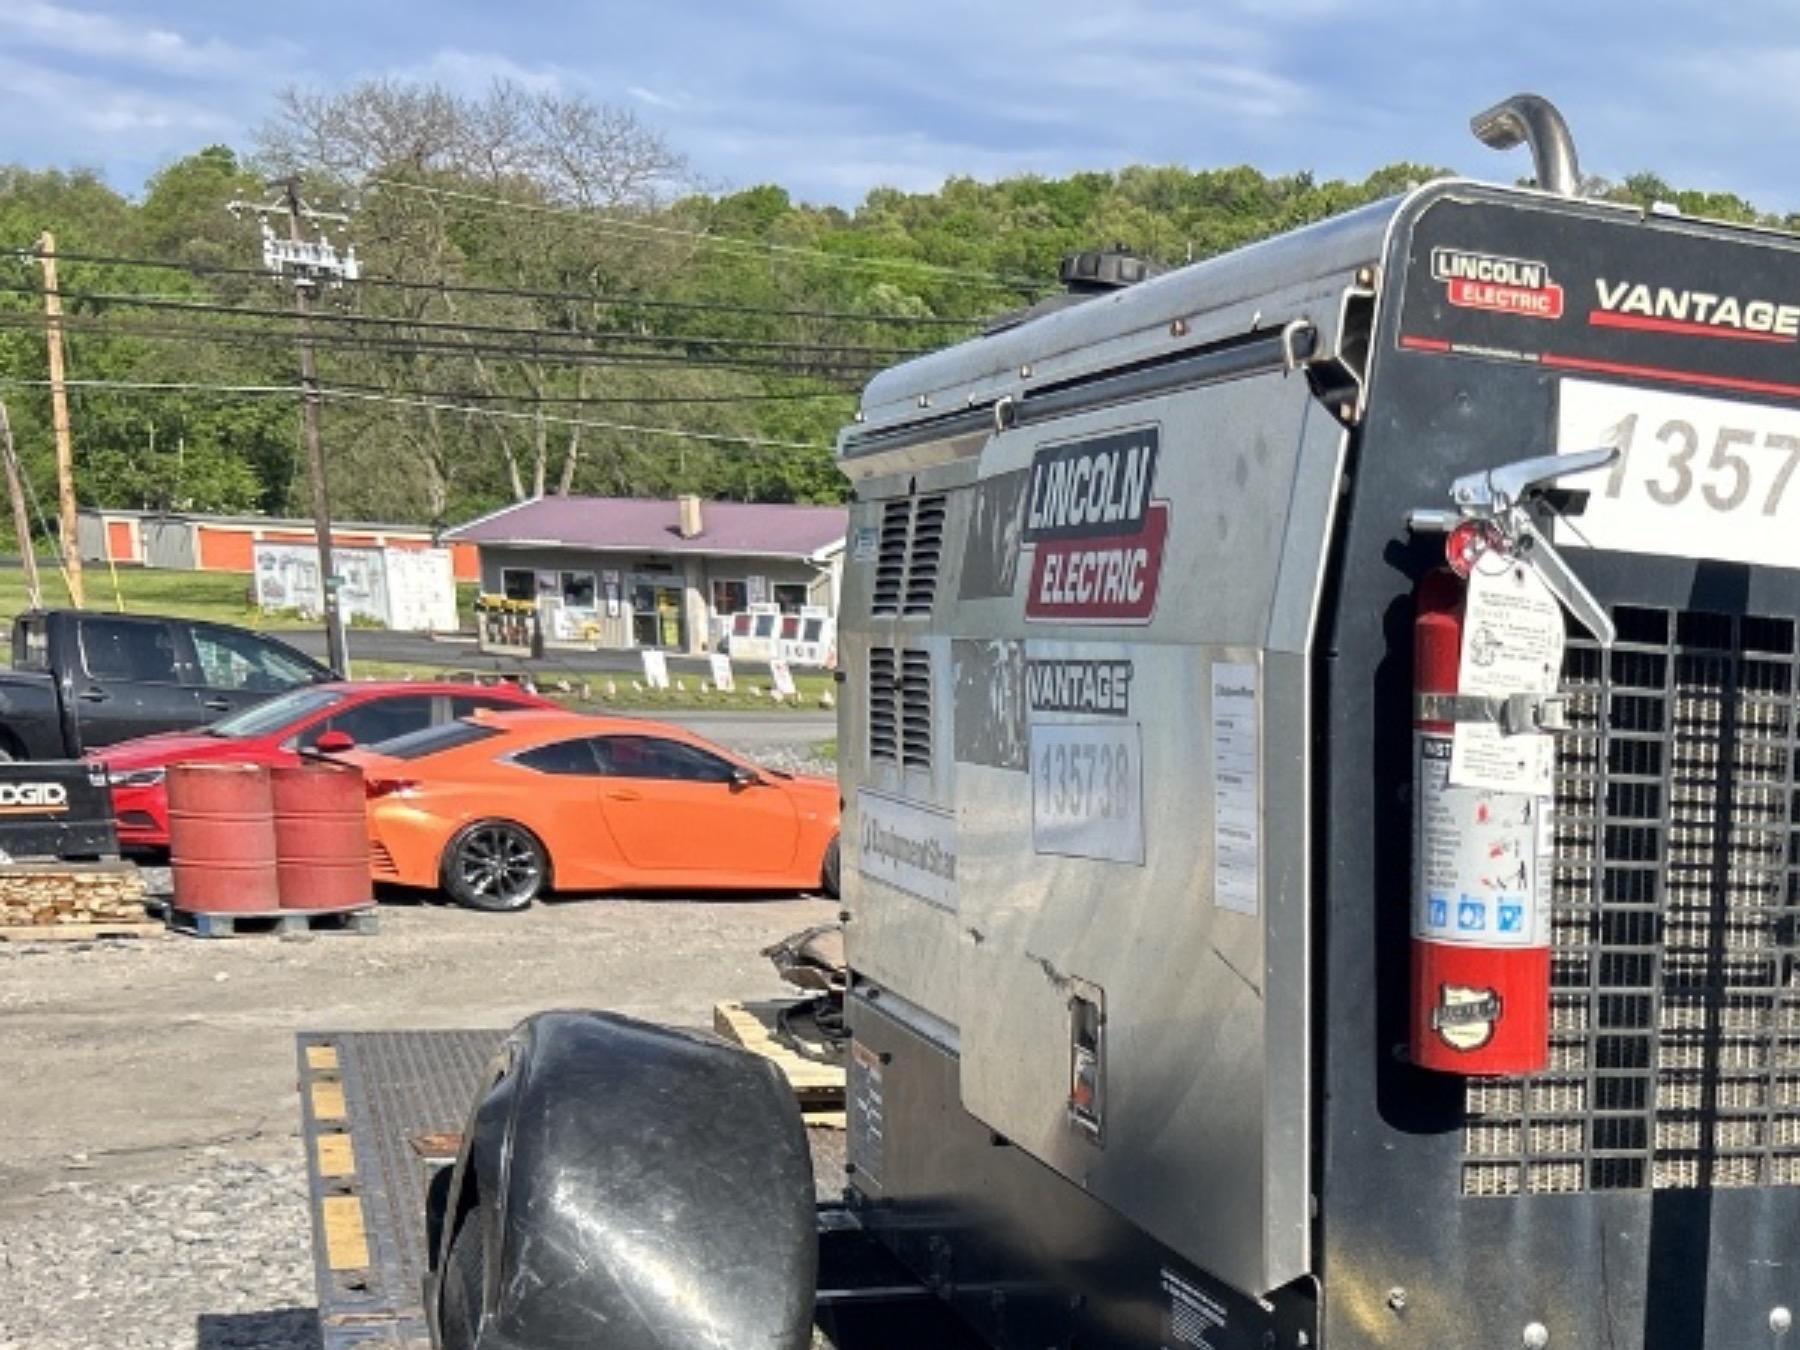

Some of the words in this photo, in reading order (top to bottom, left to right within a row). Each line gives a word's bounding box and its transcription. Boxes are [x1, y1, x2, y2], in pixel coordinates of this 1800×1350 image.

[1437, 252, 1541, 289] LINCOLN
[1461, 284, 1551, 312] ELECTRIC
[1027, 446, 1151, 530] LINCOLN
[1039, 547, 1148, 605] ELECTRIC
[1027, 664, 1127, 709] VANTAGE
[1040, 742, 1131, 820] 135738
